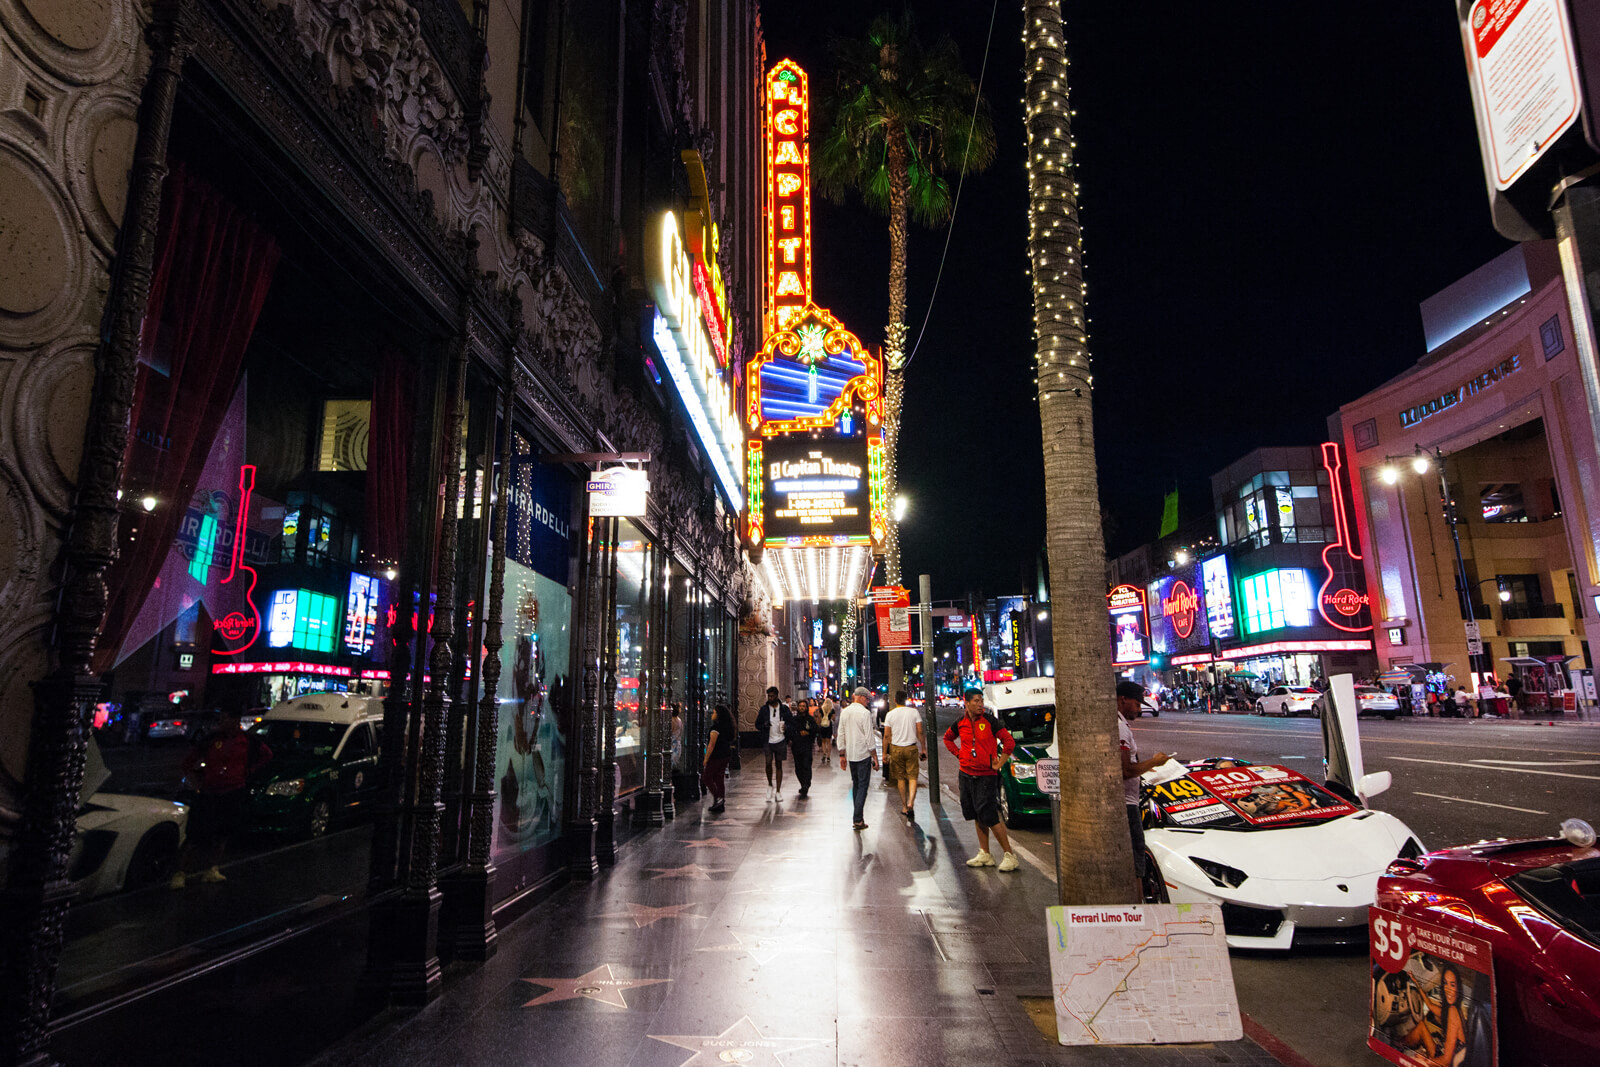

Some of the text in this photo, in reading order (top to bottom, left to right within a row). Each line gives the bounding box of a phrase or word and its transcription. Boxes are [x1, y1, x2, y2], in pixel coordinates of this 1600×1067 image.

[772, 81, 803, 105] EL
[1420, 353, 1522, 419] DOLBY THEATRE
[808, 451, 823, 459] THE
[770, 458, 862, 480] El Capitan Theatre
[1111, 591, 1137, 601] CHINESE
[1163, 588, 1199, 617] Hard Rock
[1324, 594, 1370, 606] Hard Rock
[1012, 619, 1020, 667] CHINESE
[1202, 771, 1251, 785] $10
[1184, 800, 1209, 809] DEPOSIT
[1071, 911, 1143, 923] Ferrari Limo Tour
[1374, 914, 1404, 961] $5
[1416, 927, 1431, 940] TAKE
[1431, 931, 1451, 946] YOUR
[1451, 939, 1478, 955] PICTURE
[1416, 939, 1465, 963] INSIDE THE CAR
